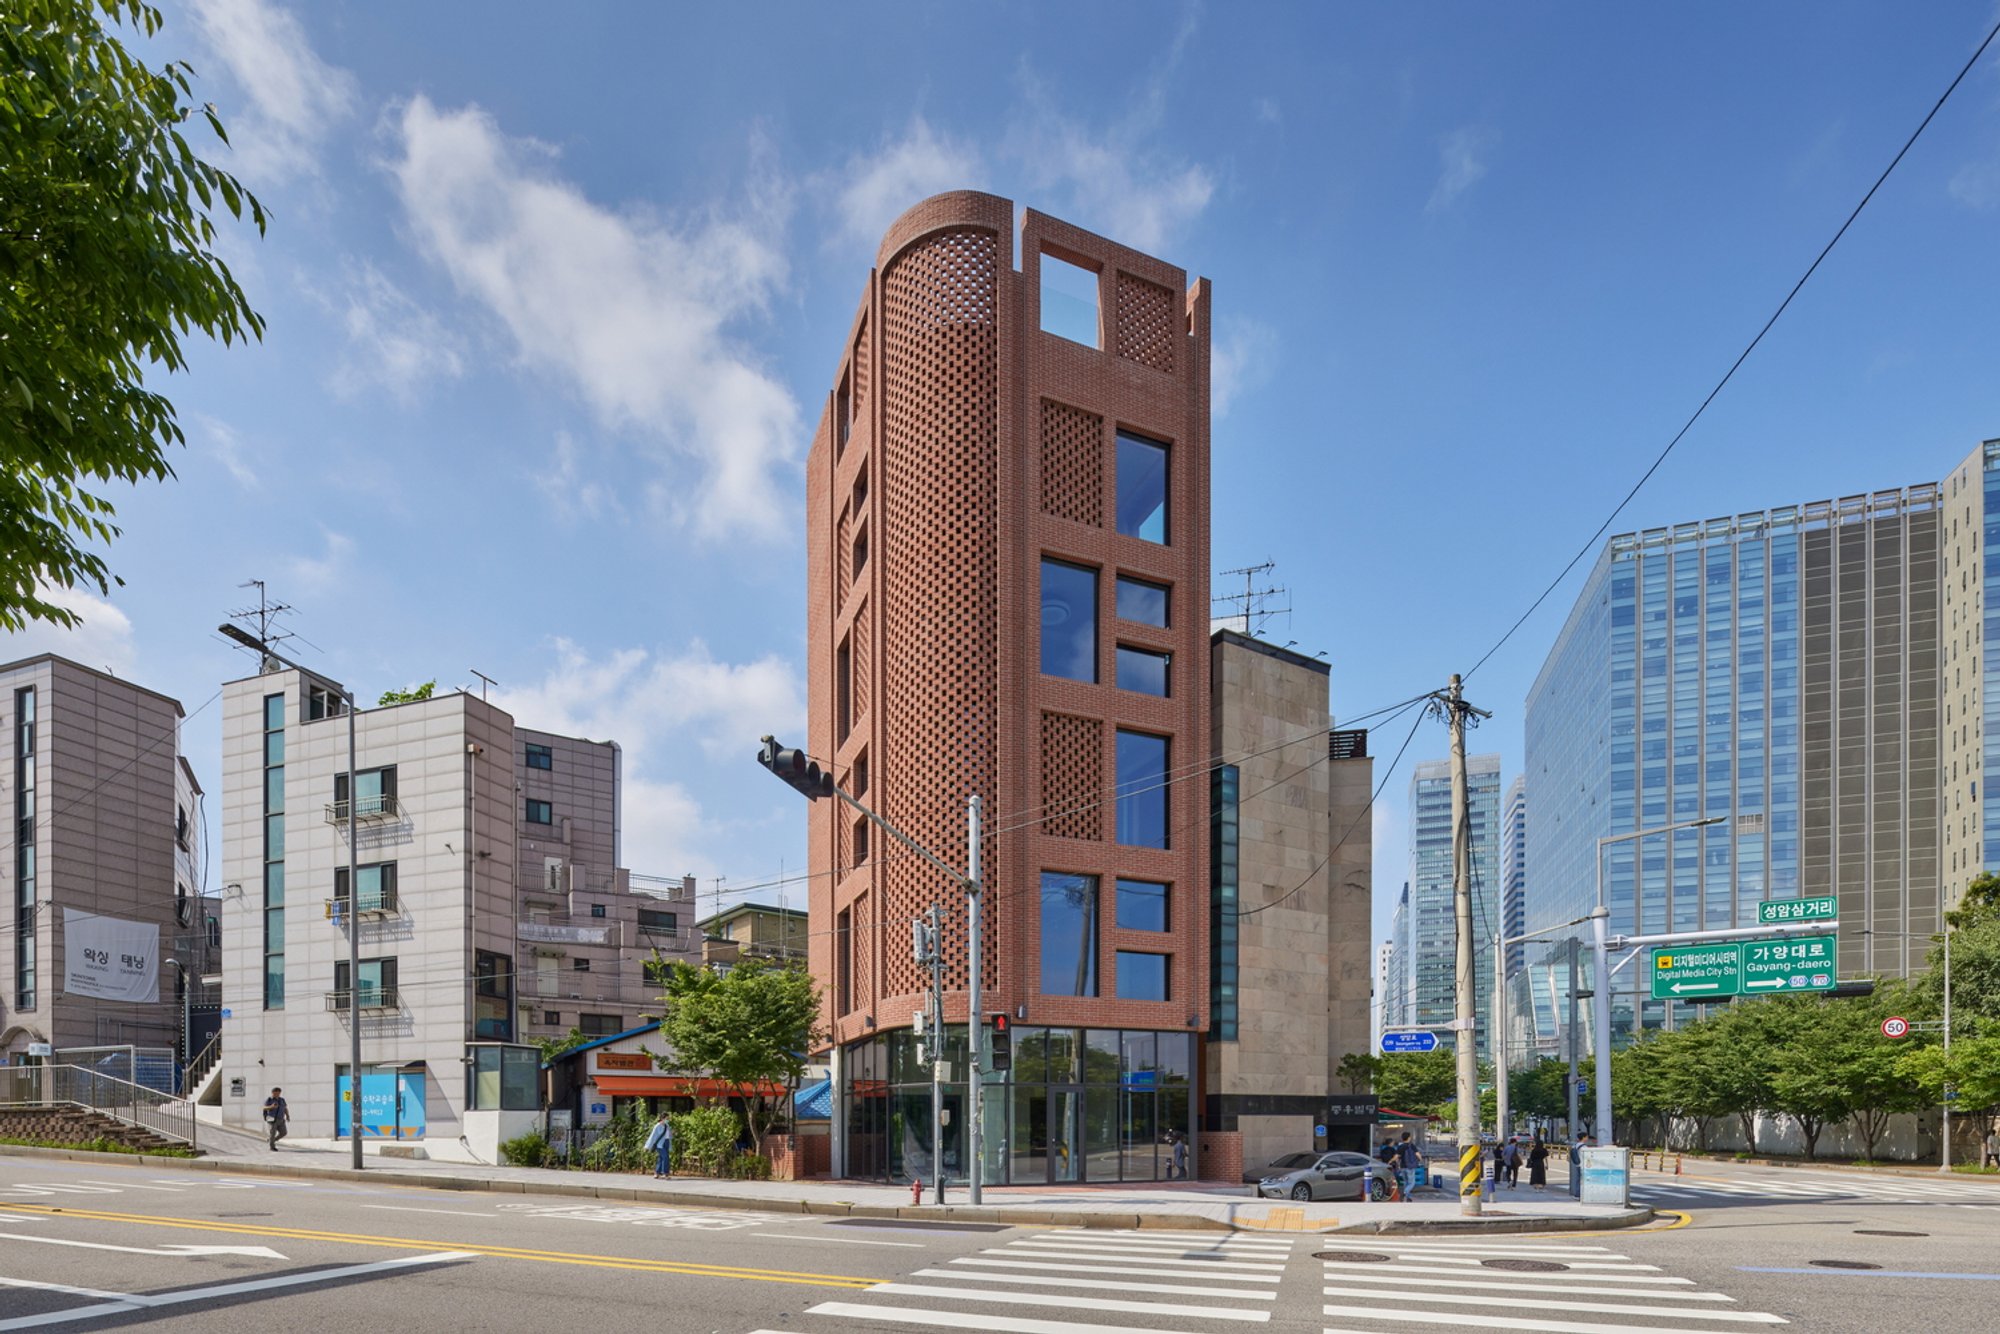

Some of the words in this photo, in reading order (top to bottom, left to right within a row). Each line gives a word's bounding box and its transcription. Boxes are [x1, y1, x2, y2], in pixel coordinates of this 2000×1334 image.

[1764, 901, 1832, 918] 성암삼거리
[84, 948, 109, 965] 왁싱
[121, 954, 144, 969] 태닝
[1673, 951, 1737, 967] 디지털미디어시티역
[1753, 944, 1825, 960] 가양대로
[1657, 970, 1681, 981] Digital
[1682, 968, 1706, 978] Media
[1706, 967, 1722, 978] City
[1723, 966, 1737, 975] Stn
[1746, 960, 1831, 973] Gayang-daero
[1791, 976, 1804, 986] 50
[1814, 977, 1826, 986] 70
[1888, 1022, 1903, 1032] 50
